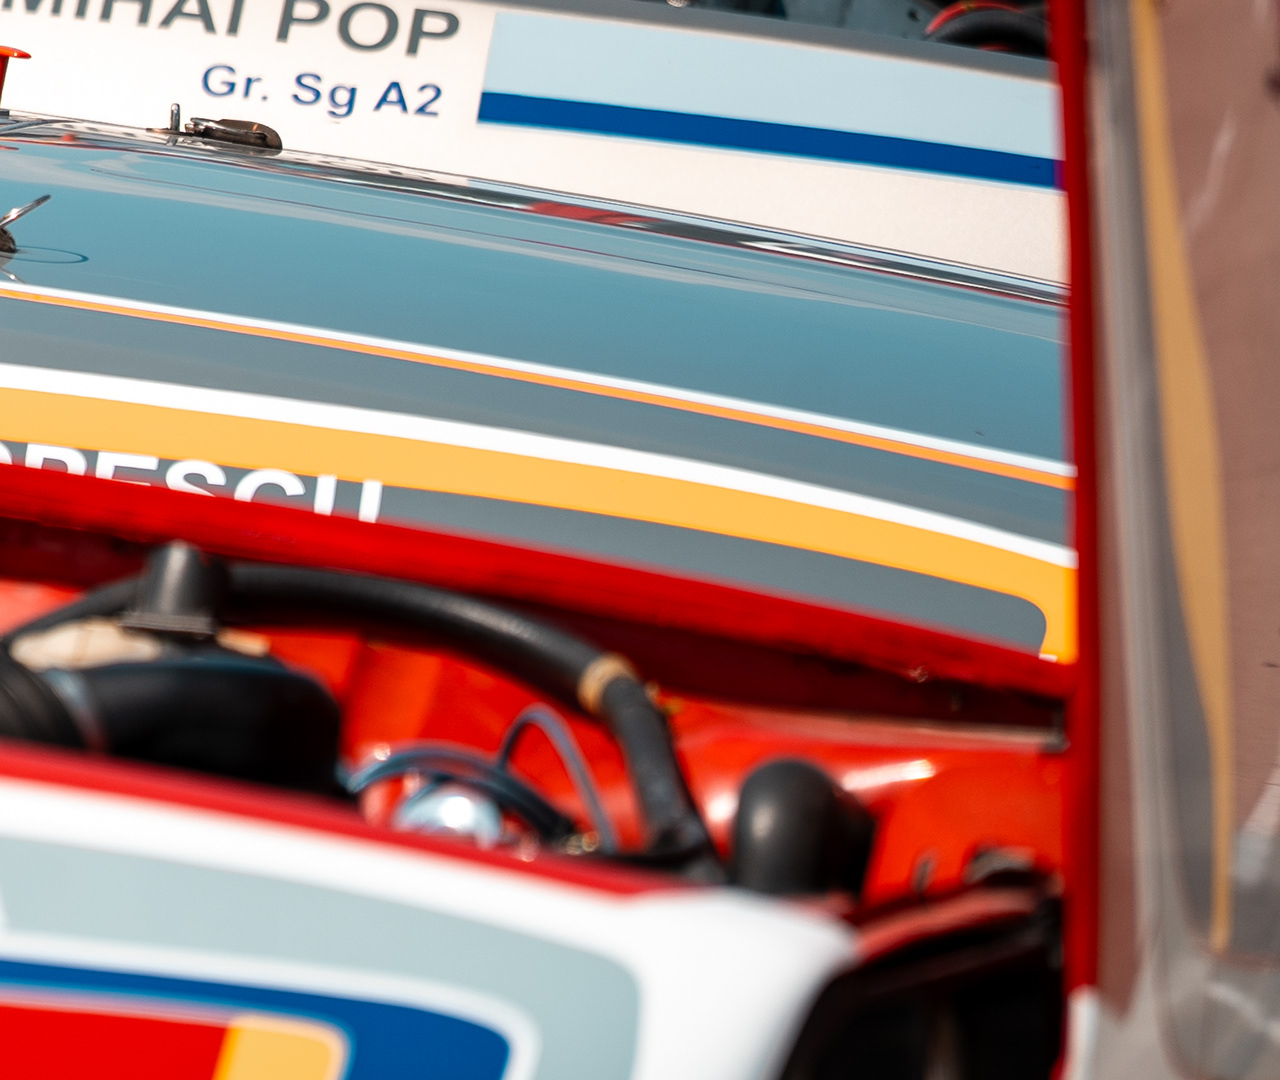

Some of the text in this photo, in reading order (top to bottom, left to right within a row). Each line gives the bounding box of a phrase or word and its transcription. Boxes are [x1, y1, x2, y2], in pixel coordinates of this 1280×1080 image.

[201, 64, 443, 119] Gr. Sg A2
